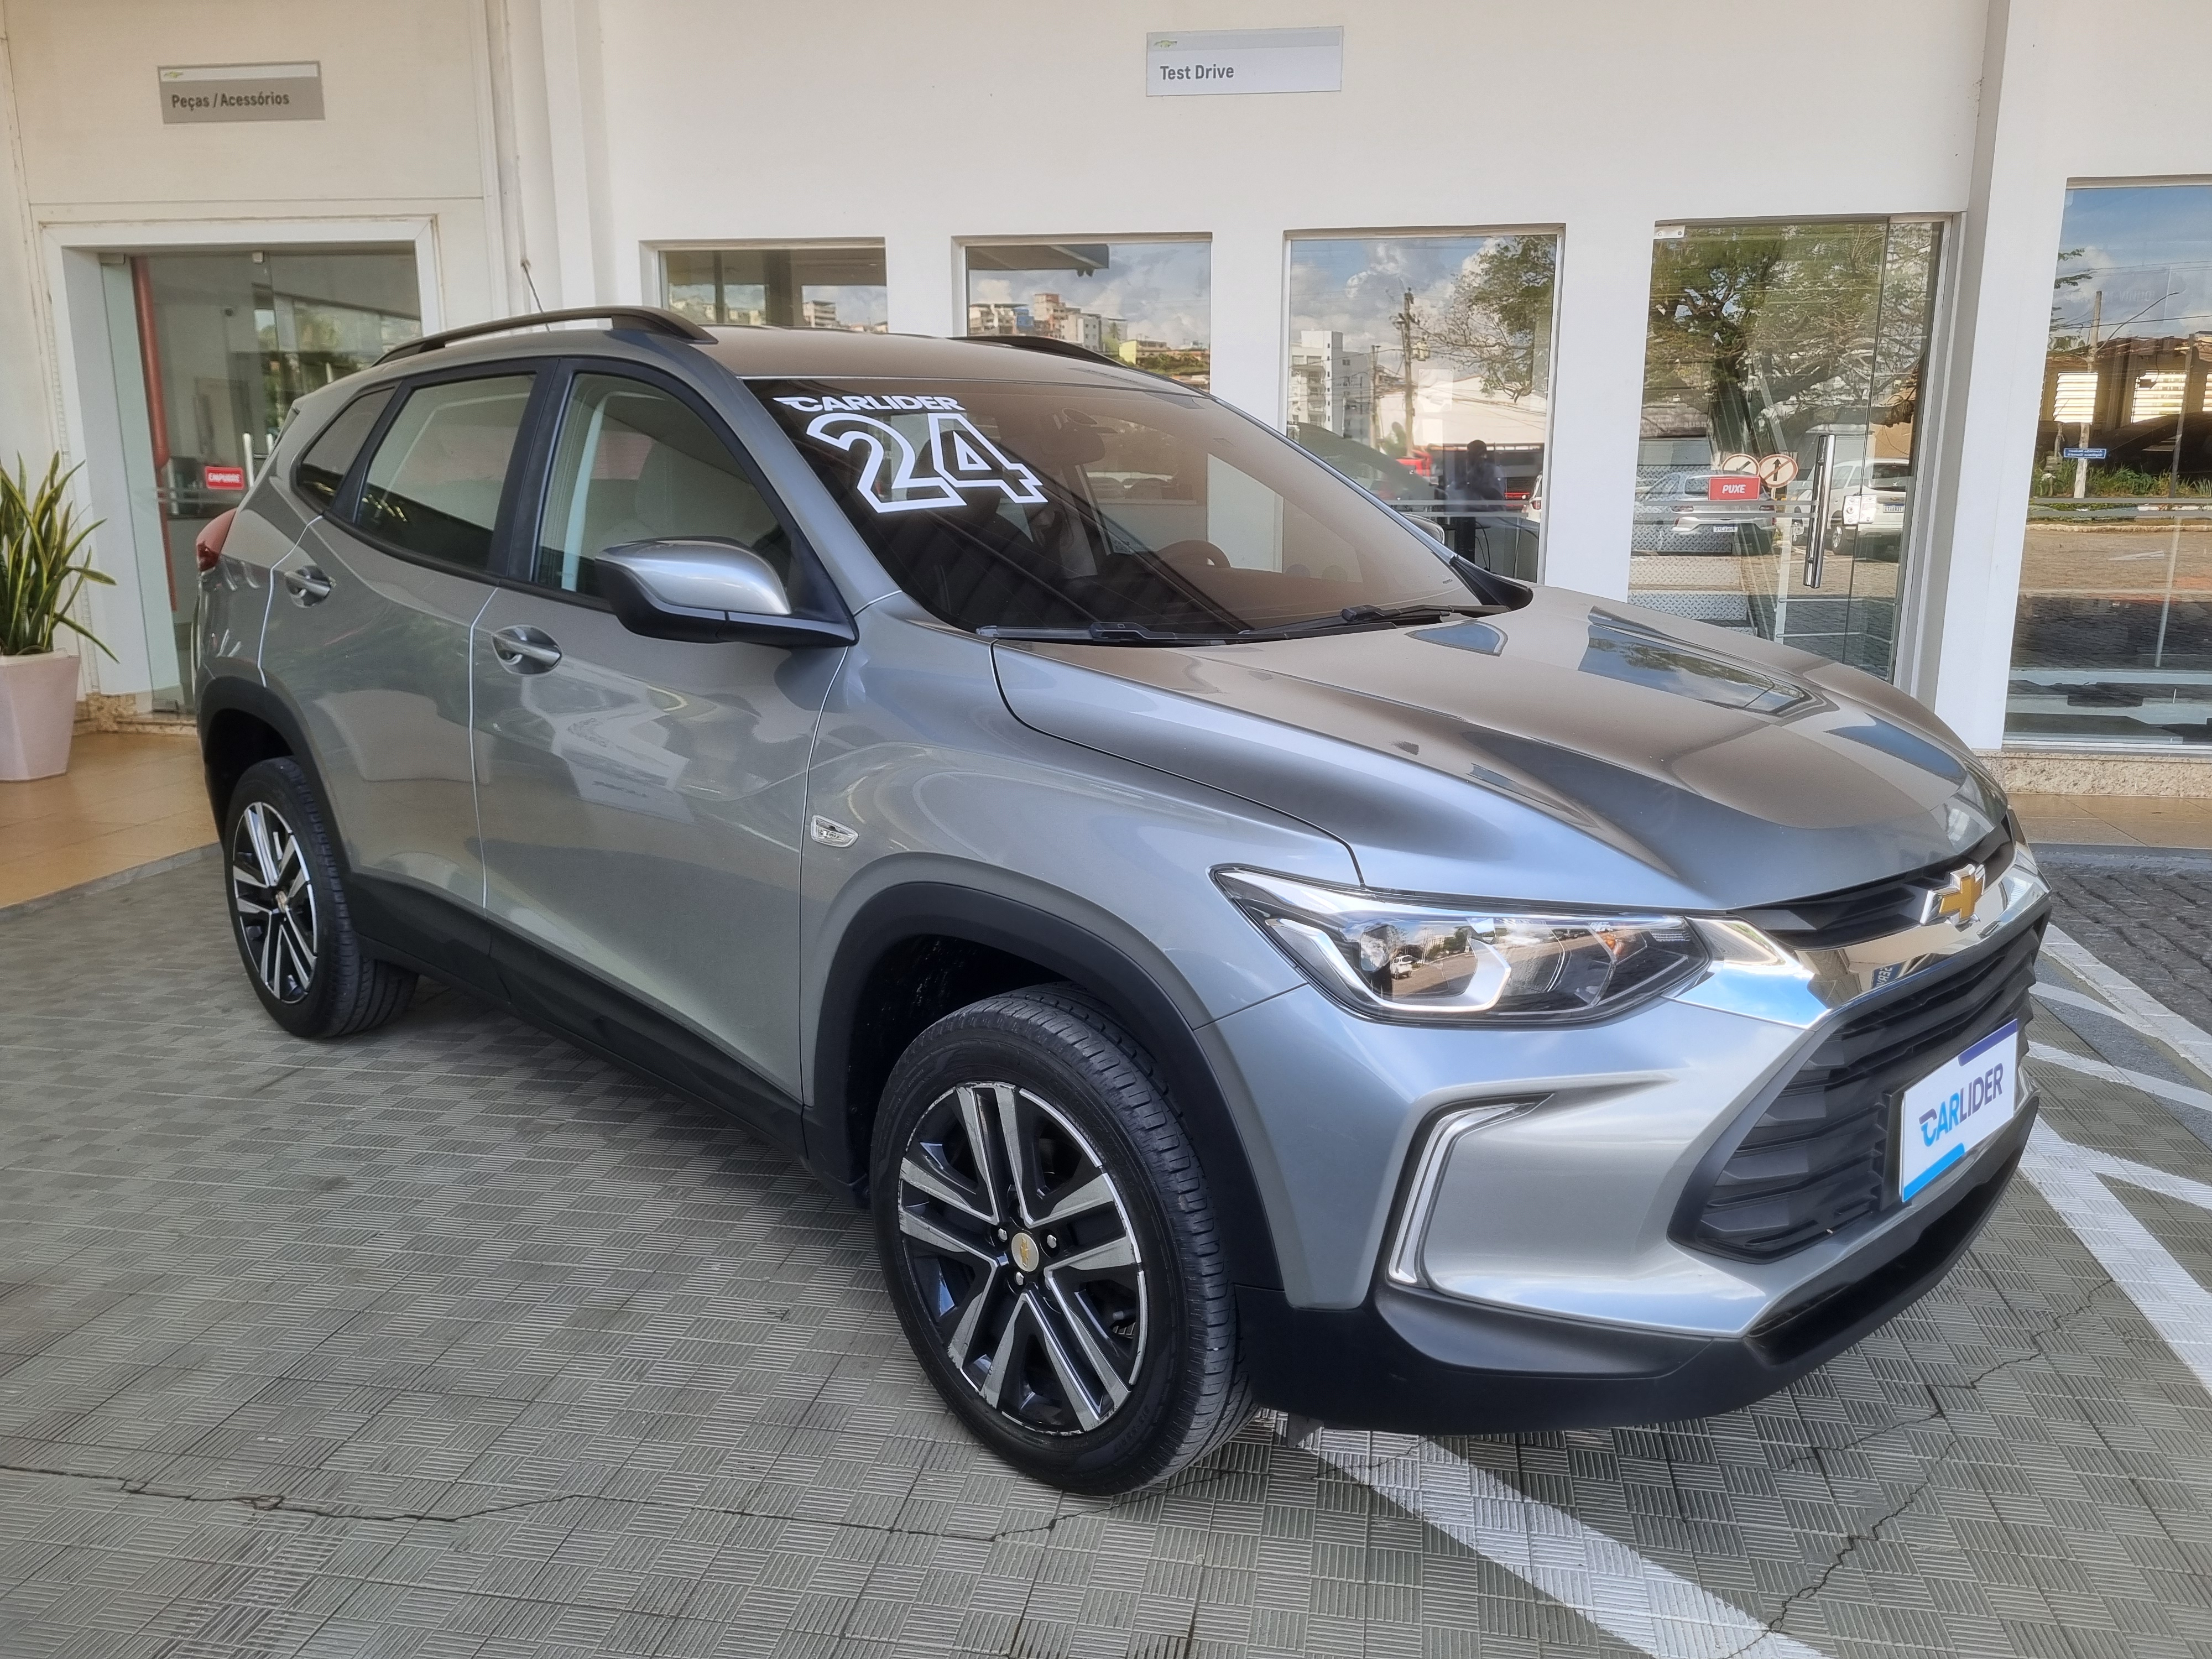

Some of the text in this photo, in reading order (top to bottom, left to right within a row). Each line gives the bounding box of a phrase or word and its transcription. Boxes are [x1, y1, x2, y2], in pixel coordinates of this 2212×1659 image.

[1160, 63, 1234, 80] Test Drive
[171, 94, 210, 111] Peças
[221, 91, 290, 107] Acessórios
[773, 395, 966, 413] CARLIDER
[806, 412, 1048, 514] 24
[1721, 484, 1746, 494] PUXE
[1918, 1062, 2004, 1147] CARLIDER
